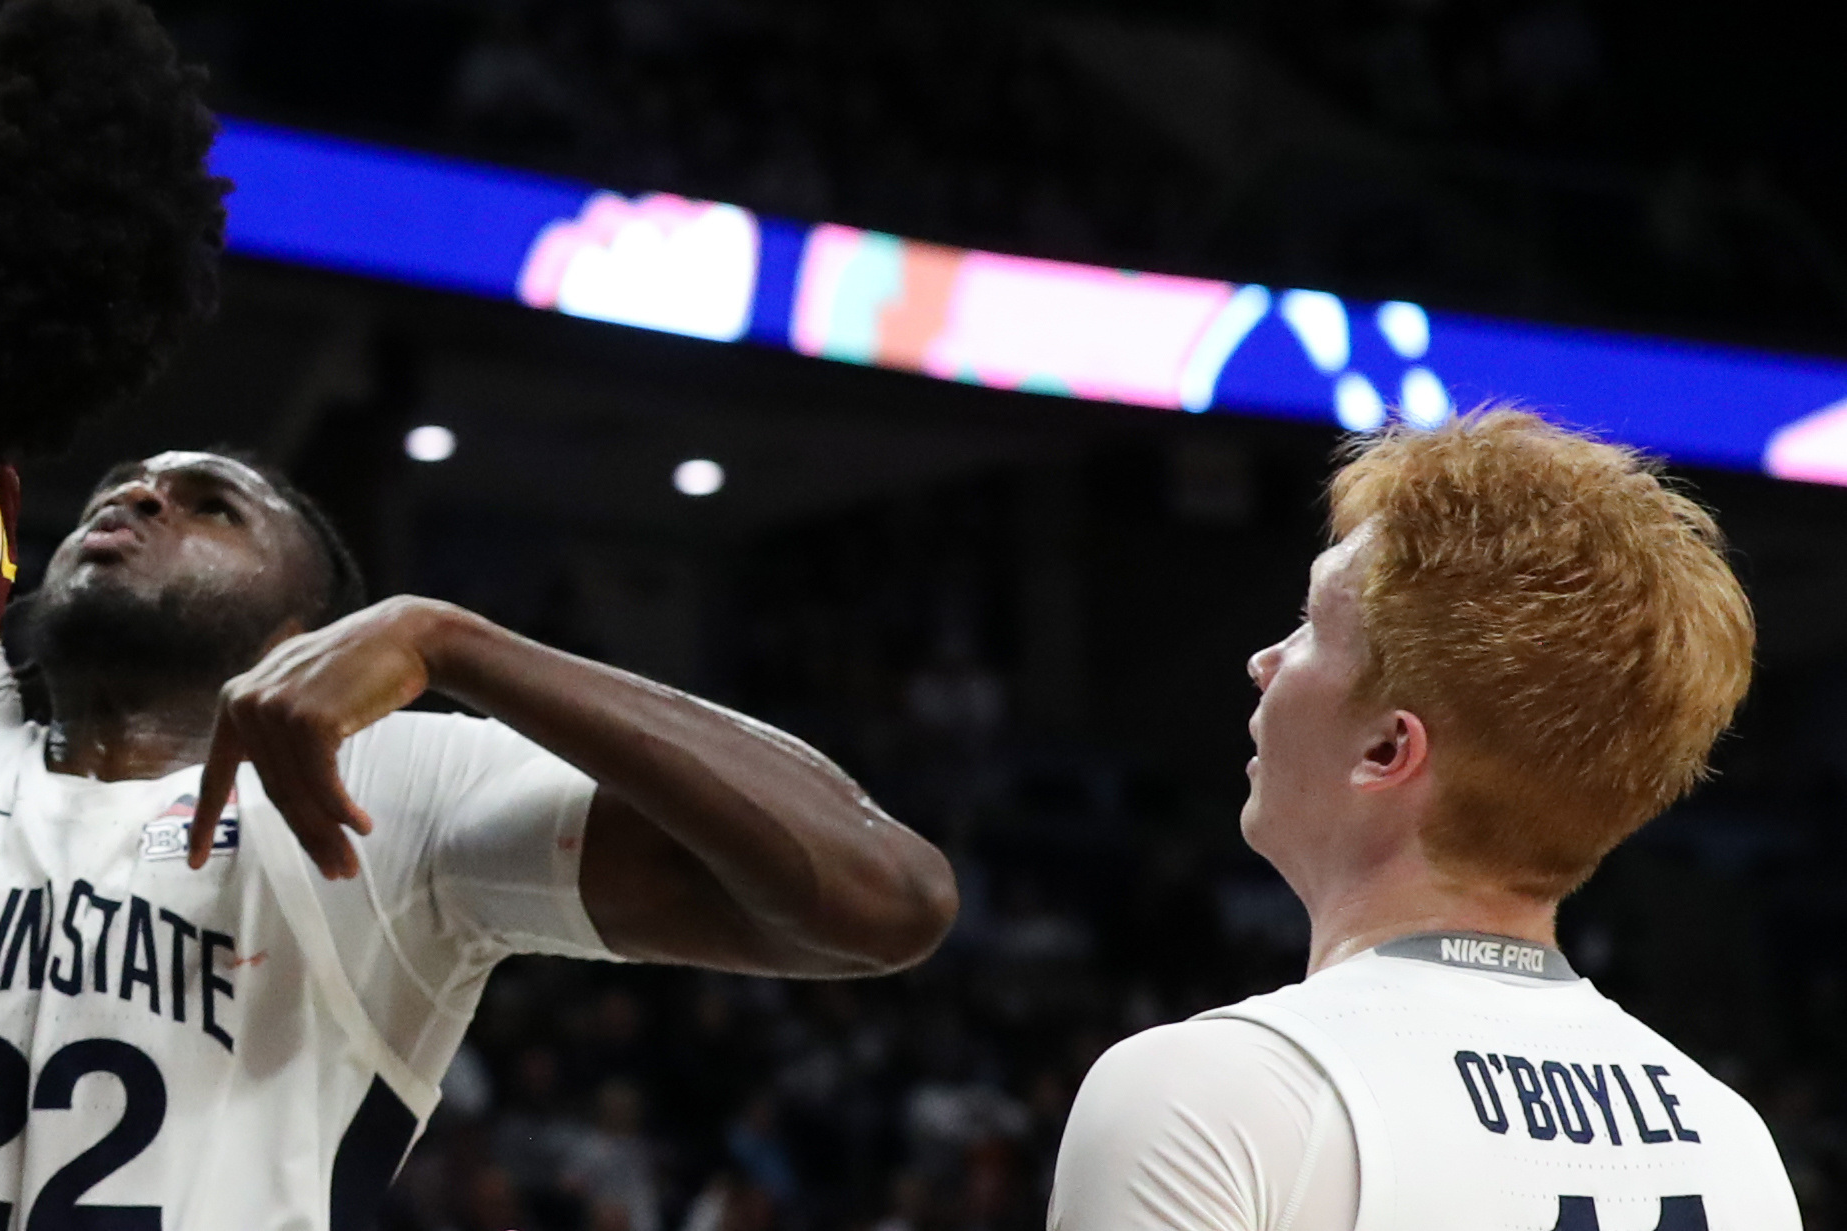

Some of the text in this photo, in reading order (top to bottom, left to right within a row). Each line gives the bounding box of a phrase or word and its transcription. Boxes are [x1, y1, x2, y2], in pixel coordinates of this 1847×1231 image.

[142, 819, 239, 855] BG
[50, 879, 236, 1054] STATE
[1441, 938, 1545, 974] NIKE PRO
[1454, 1049, 1702, 1146] O'BOYLE
